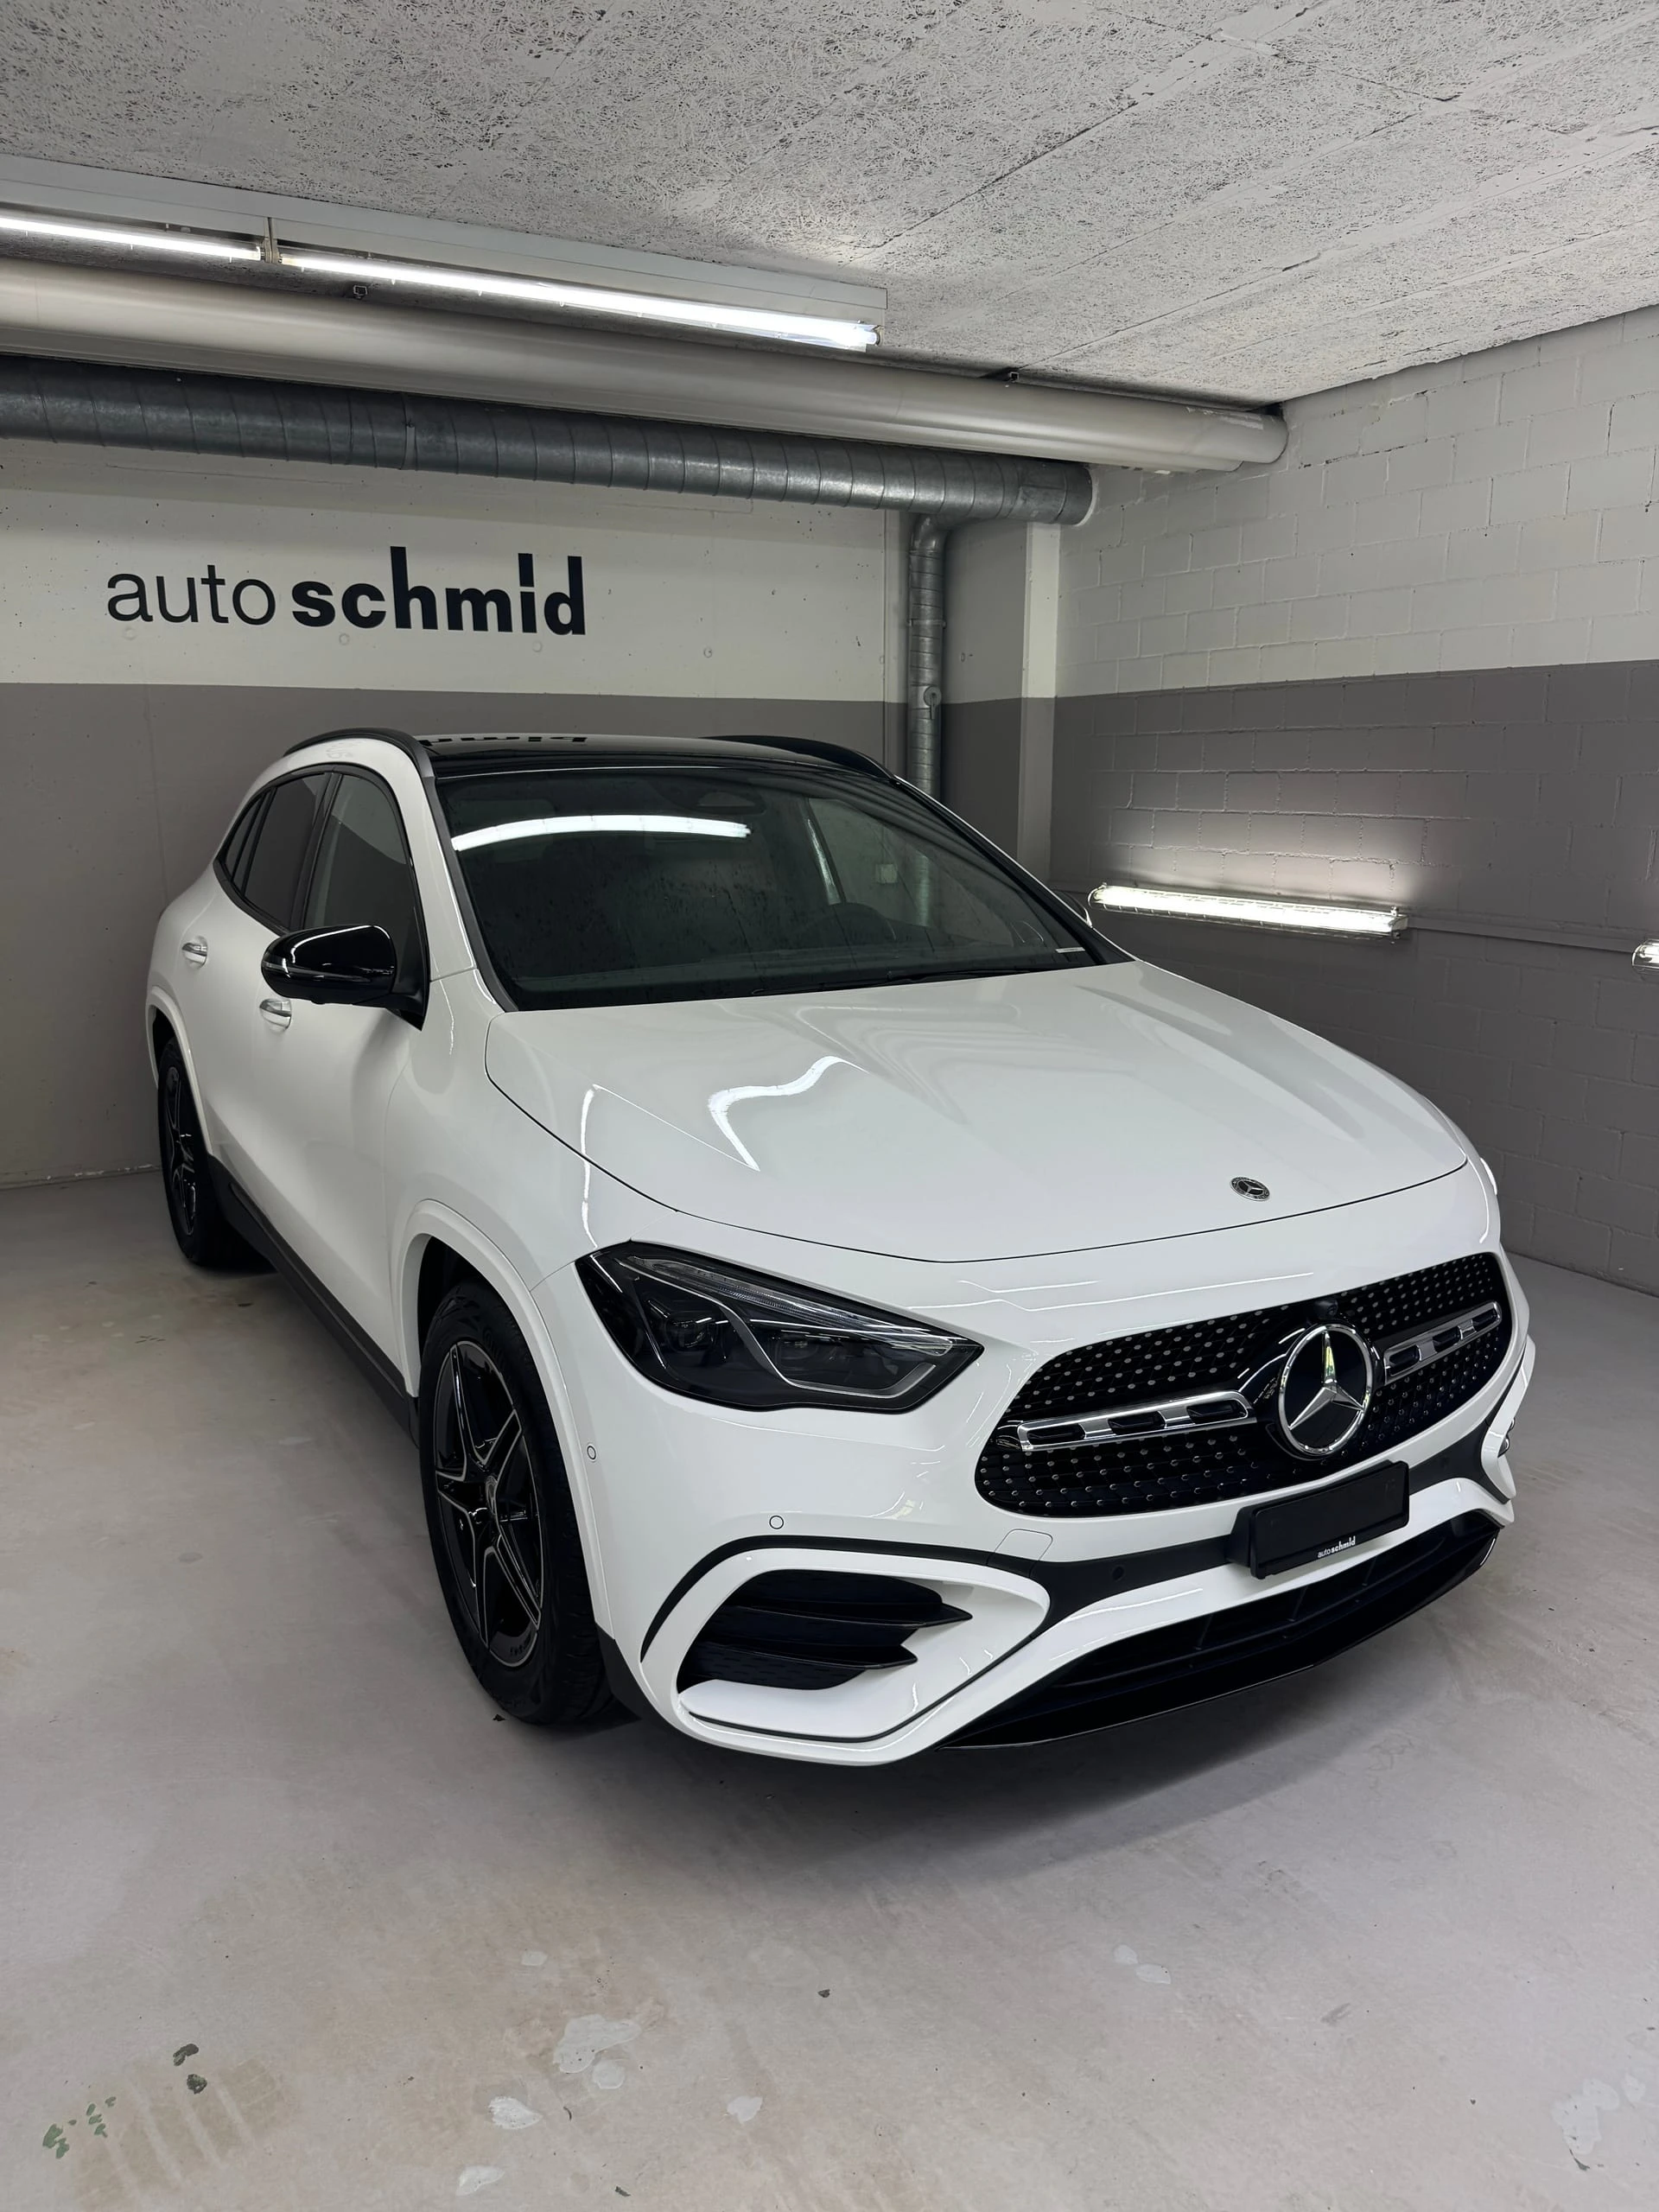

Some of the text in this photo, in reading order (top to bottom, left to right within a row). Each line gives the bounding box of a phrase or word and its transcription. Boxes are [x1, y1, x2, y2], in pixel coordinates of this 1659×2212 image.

[106, 545, 587, 635] auto schmid
[1317, 1535, 1356, 1558] auto schmid
